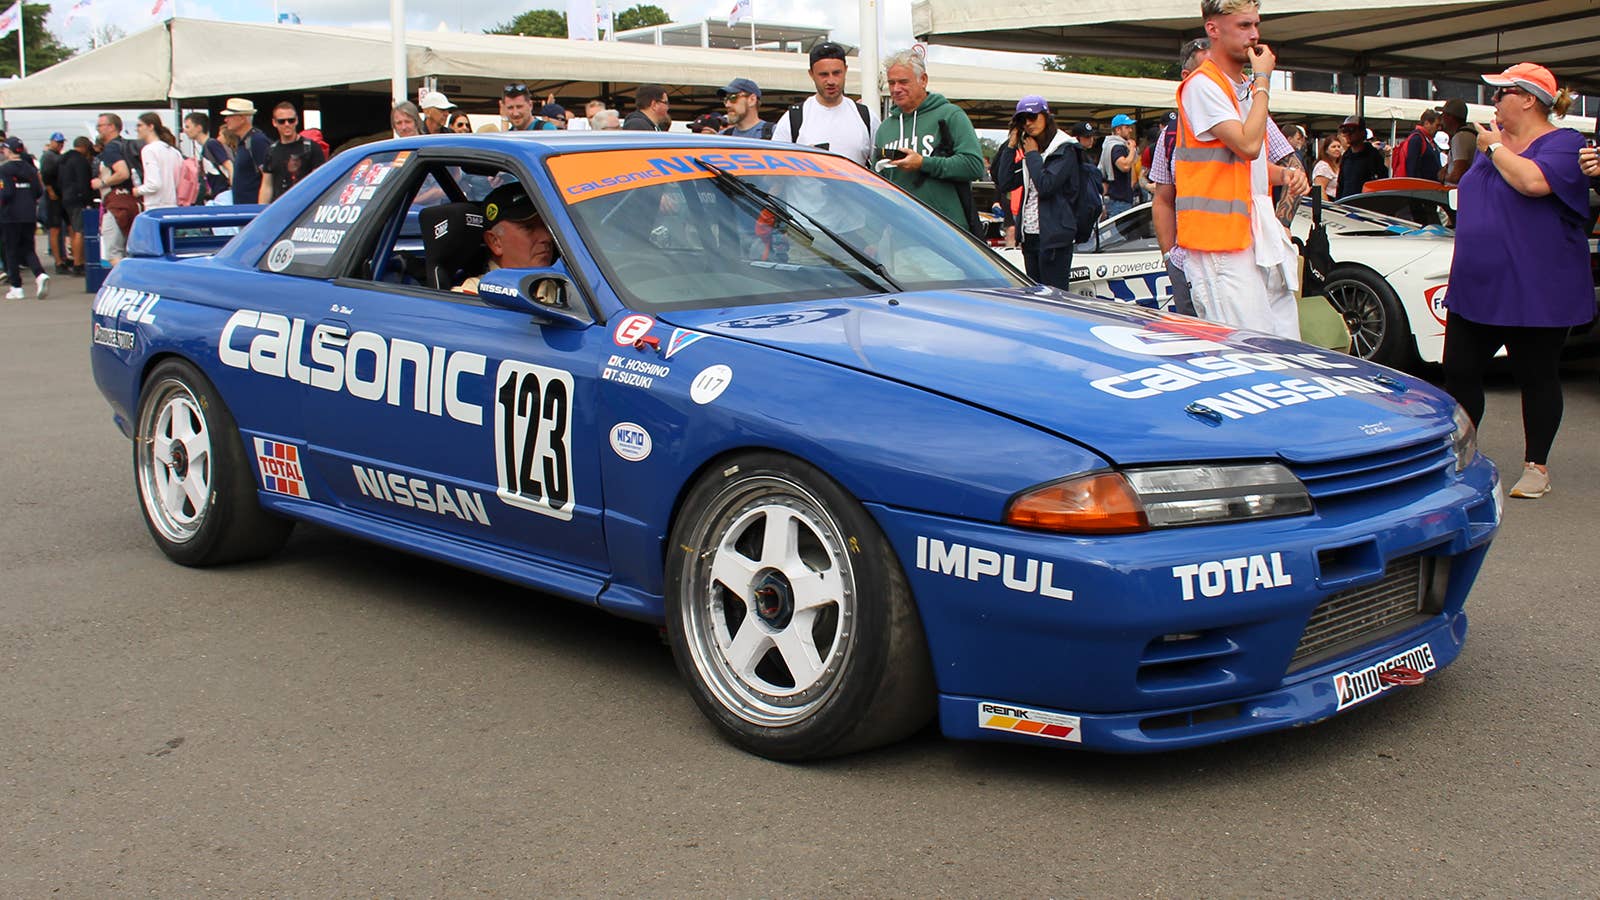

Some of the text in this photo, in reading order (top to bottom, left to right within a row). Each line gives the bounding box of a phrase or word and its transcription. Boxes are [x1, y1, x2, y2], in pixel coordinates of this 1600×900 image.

[648, 153, 825, 176] NISSAN
[314, 205, 361, 224] WOOD
[291, 227, 345, 244] MIDDLEHURST
[435, 224, 448, 236] OMP
[1112, 259, 1160, 276] powered
[480, 283, 518, 298] NISSAN
[96, 286, 160, 324] IMPUL
[622, 319, 646, 338] E
[610, 368, 653, 389] T.SUZUKI
[696, 374, 723, 392] 117
[1200, 375, 1394, 419] NISSAN
[498, 371, 568, 508] 123
[617, 428, 644, 446] NISMO
[259, 456, 303, 481] TOTAL
[352, 464, 491, 526] NISSAN
[916, 535, 1073, 601] IMPUL
[1172, 552, 1292, 600] TOTAL
[983, 704, 1029, 719] REINIK
